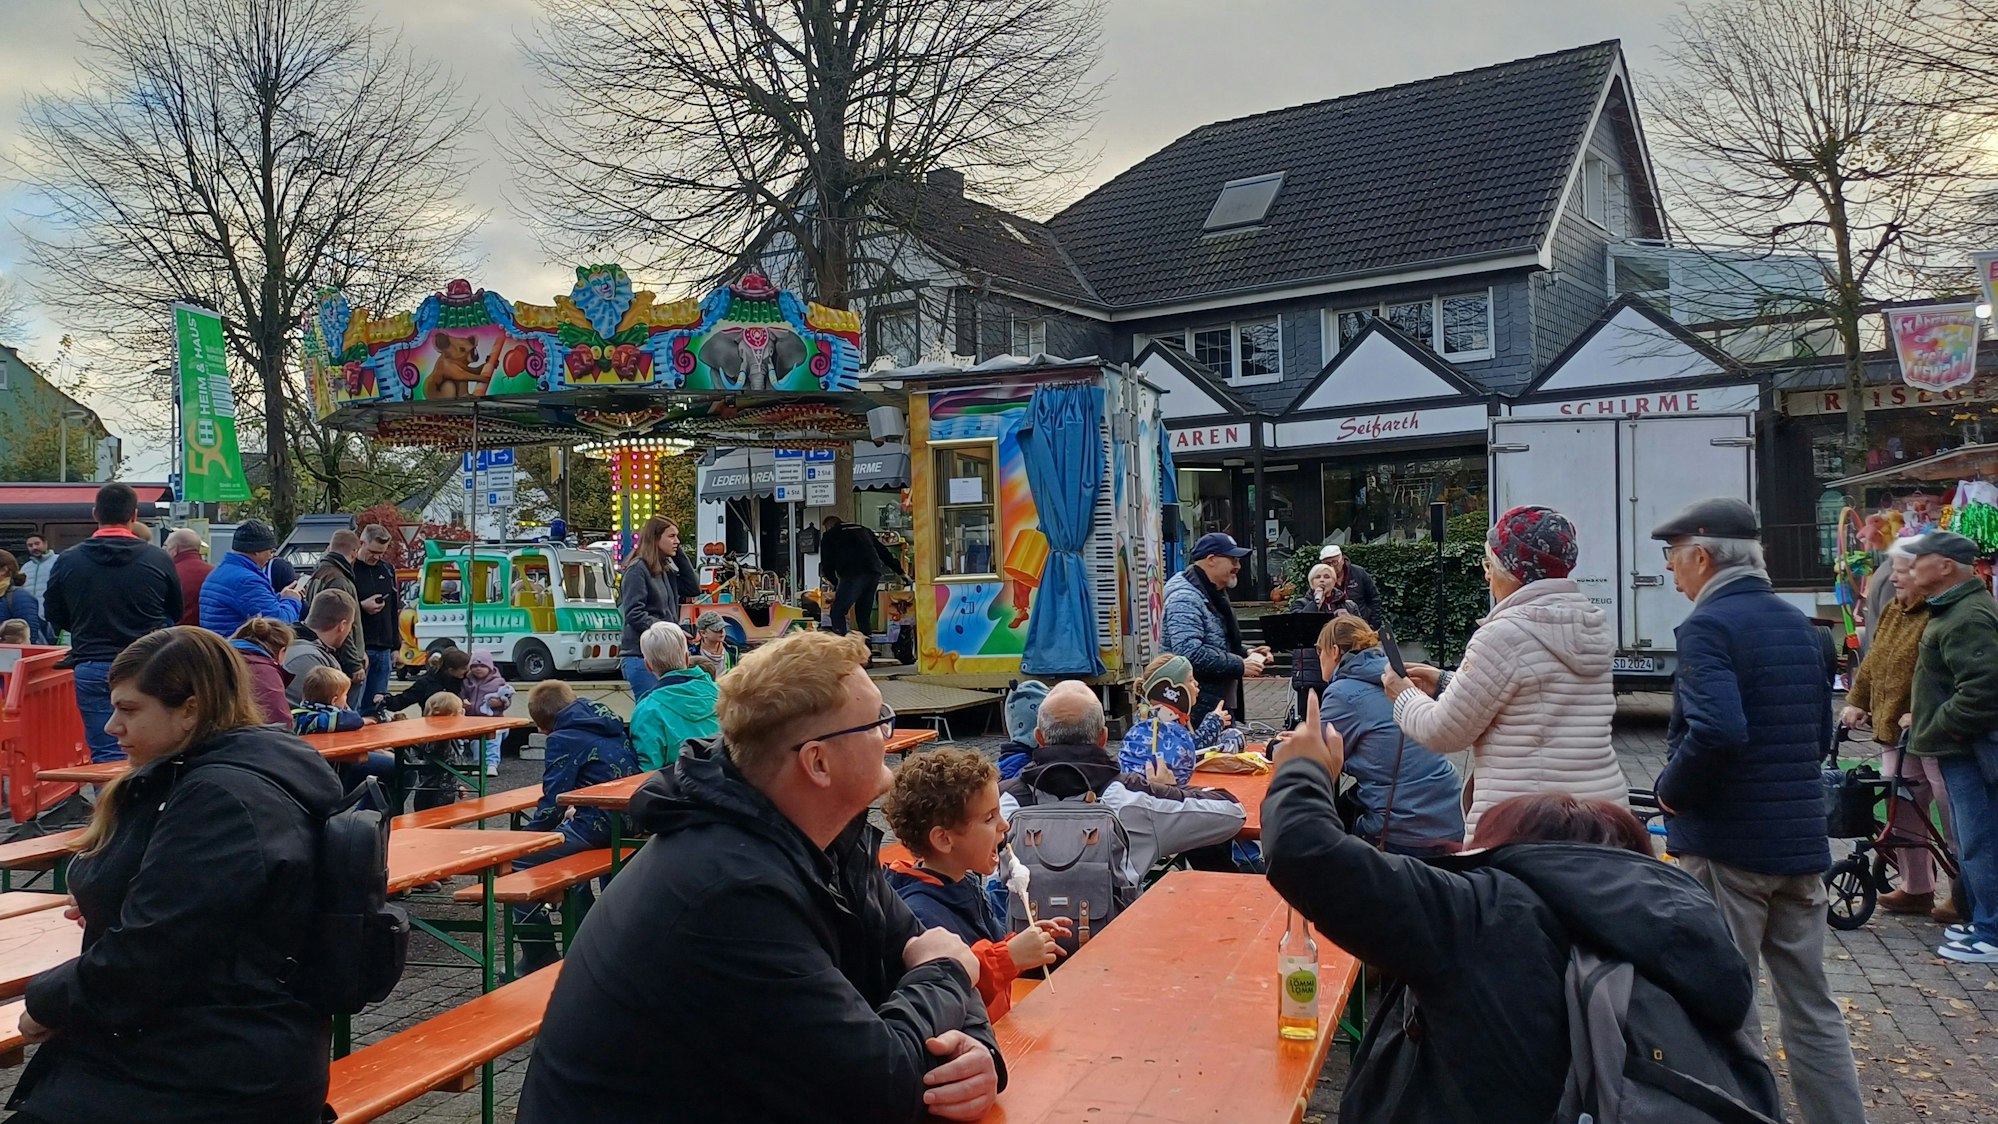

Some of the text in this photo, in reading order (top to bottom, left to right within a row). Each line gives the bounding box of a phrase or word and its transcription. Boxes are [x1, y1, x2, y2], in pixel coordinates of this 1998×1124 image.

[188, 316, 211, 415] HEIM & HAUS
[1560, 393, 1700, 415] SCHIRME
[1337, 412, 1419, 441] Seifarth
[1169, 427, 1239, 448] AREN
[711, 470, 775, 487] LEDERWAREN
[472, 611, 525, 628] POLIZEI
[575, 610, 621, 630] POLIZEI
[1613, 658, 1652, 669] SD 2024
